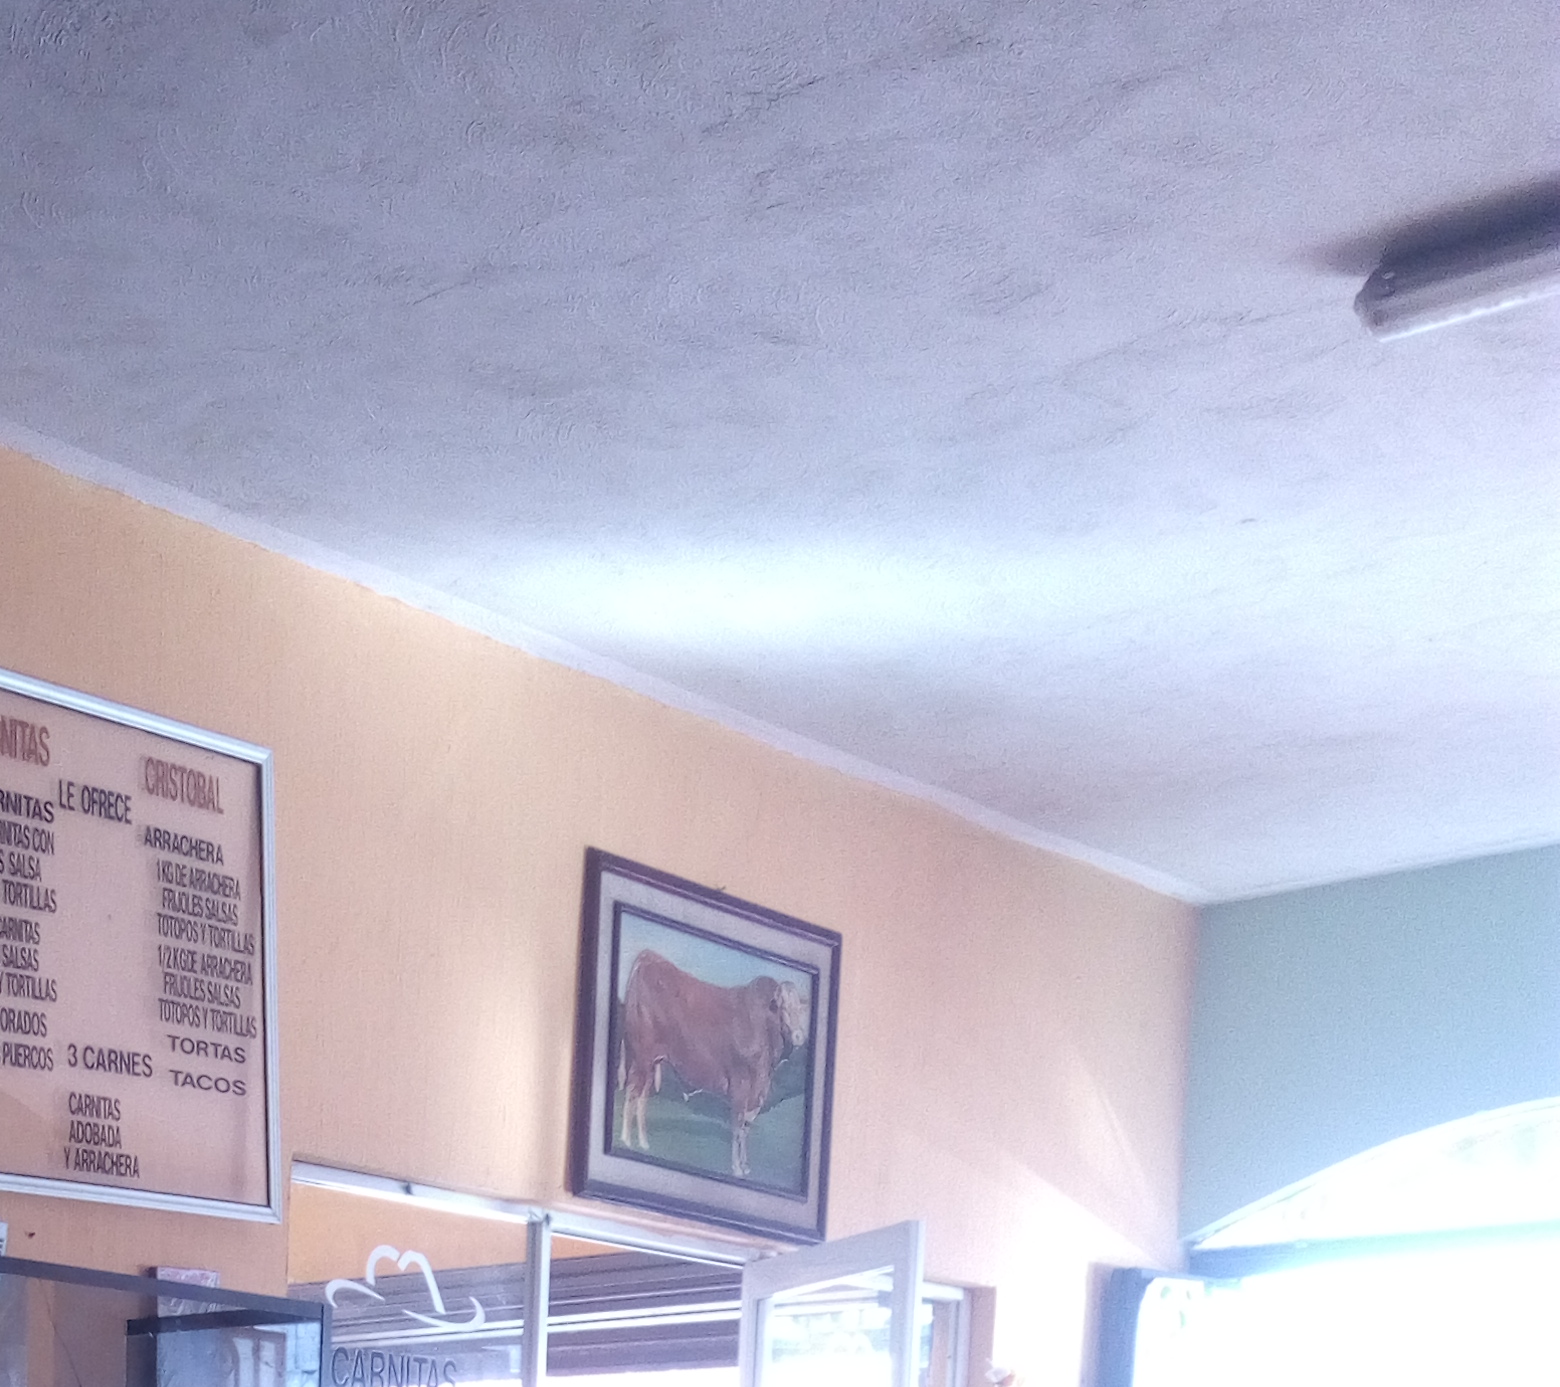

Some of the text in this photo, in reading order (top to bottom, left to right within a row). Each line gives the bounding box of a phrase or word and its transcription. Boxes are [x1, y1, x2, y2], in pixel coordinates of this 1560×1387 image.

[58, 778, 133, 825] LE OFRECE
[145, 755, 225, 815] CRISTOBAL
[33, 827, 55, 856] CON
[144, 825, 224, 866] ARRACHERA
[2, 878, 57, 914] TORTILLAS
[189, 866, 241, 901] ARRACHERA
[163, 886, 239, 927] FRIJOLES SALSAS
[157, 912, 255, 956] TOTOPOS Y TORTILLAS
[2, 943, 39, 972] SALSAS
[201, 952, 253, 986] ARRACHERA
[5, 972, 58, 1003] TORTILLAS
[164, 971, 241, 1010] FRIJOLES SALSAS
[158, 997, 258, 1040] TOTOPOS Y TORTILLAS
[2, 1041, 54, 1072] PUERCOS
[67, 1042, 154, 1079] 3 CARNES
[167, 1034, 246, 1064] TORTAS
[168, 1069, 248, 1097] TACOS
[68, 1090, 121, 1122] CARNITAS
[69, 1119, 122, 1149] ADOBADA
[63, 1145, 140, 1179] Y ARRACHERA
